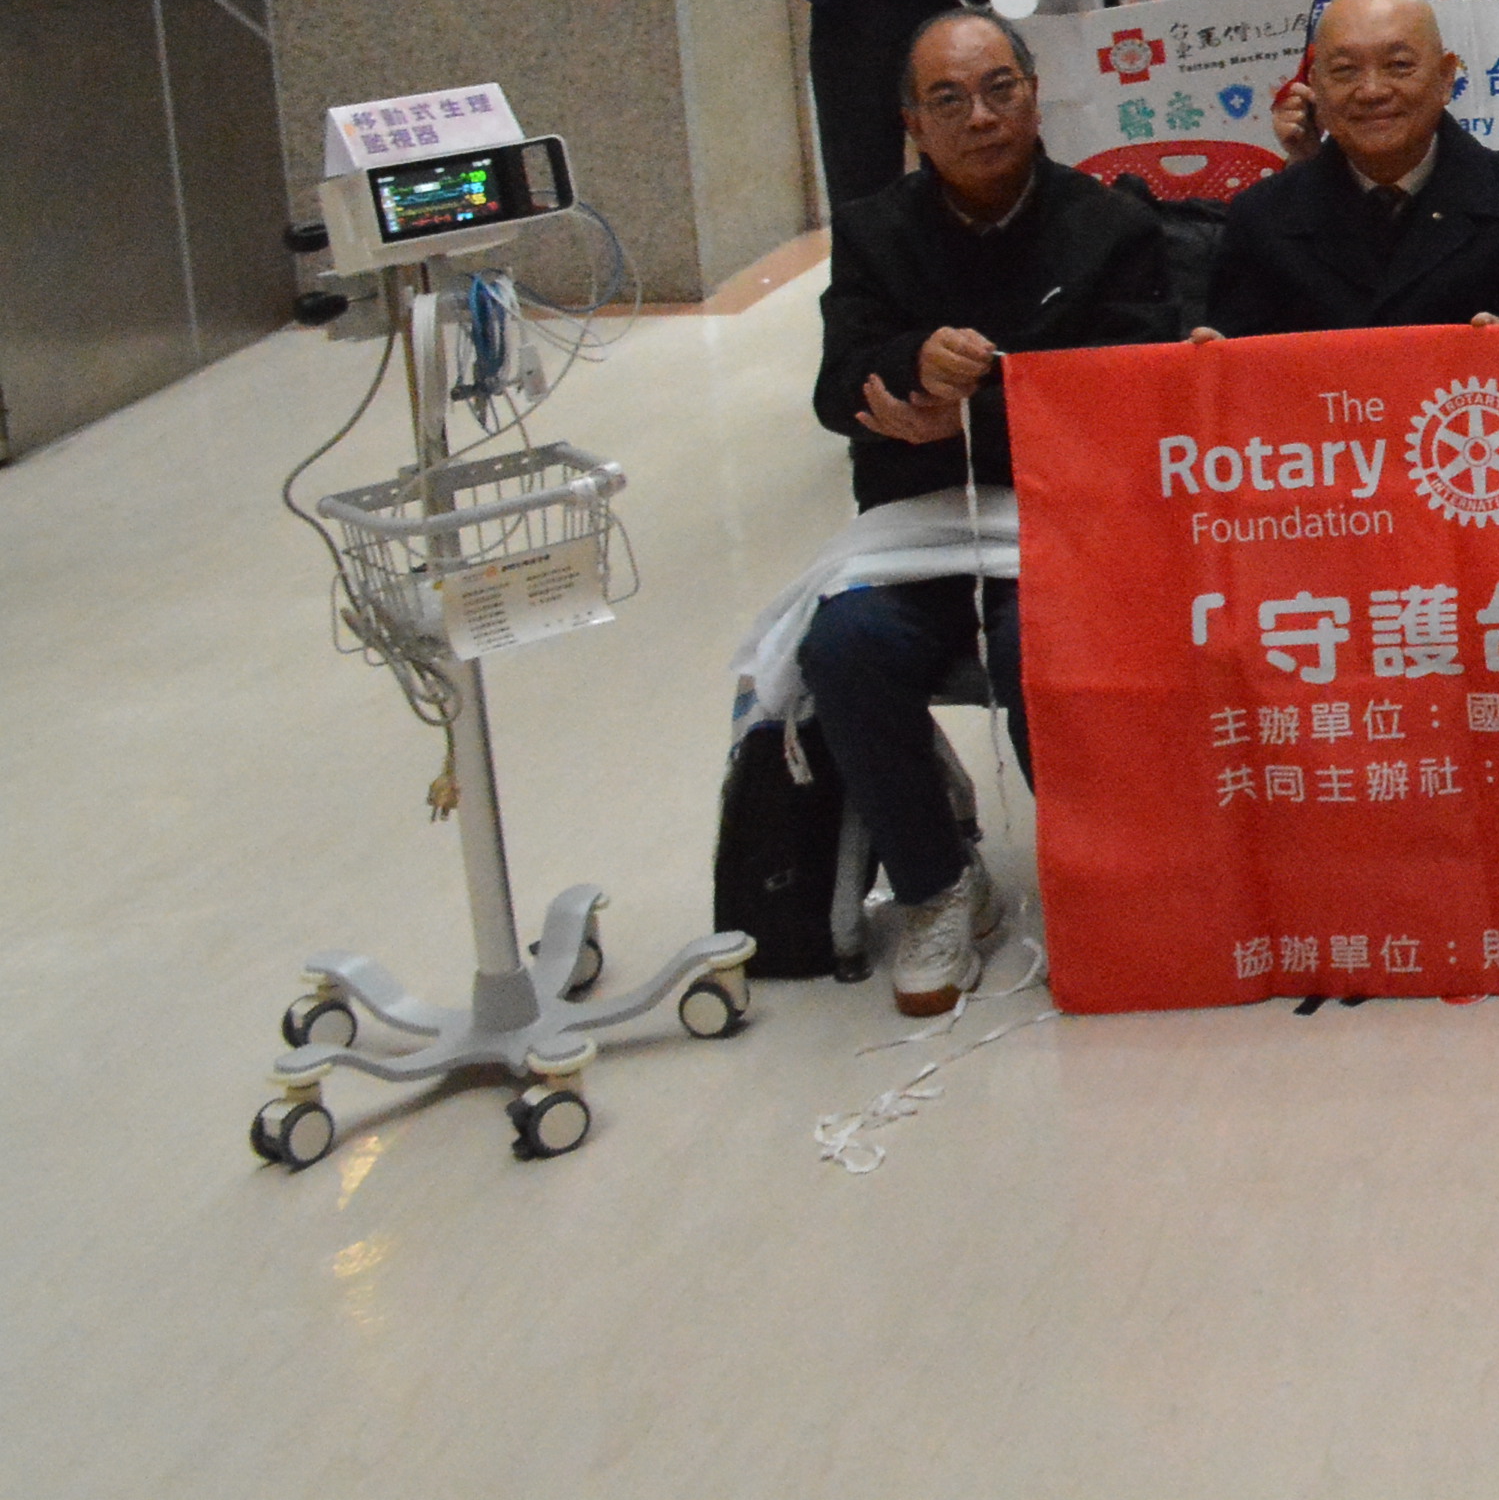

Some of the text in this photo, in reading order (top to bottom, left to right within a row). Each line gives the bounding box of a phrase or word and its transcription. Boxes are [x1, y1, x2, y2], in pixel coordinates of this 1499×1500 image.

[350, 93, 494, 130] 移動式生理
[1117, 90, 1205, 140] 醫療
[360, 124, 440, 155] 監視器
[1318, 391, 1386, 424] The
[1158, 434, 1387, 498] Rotary
[1191, 505, 1394, 545] Foundation
